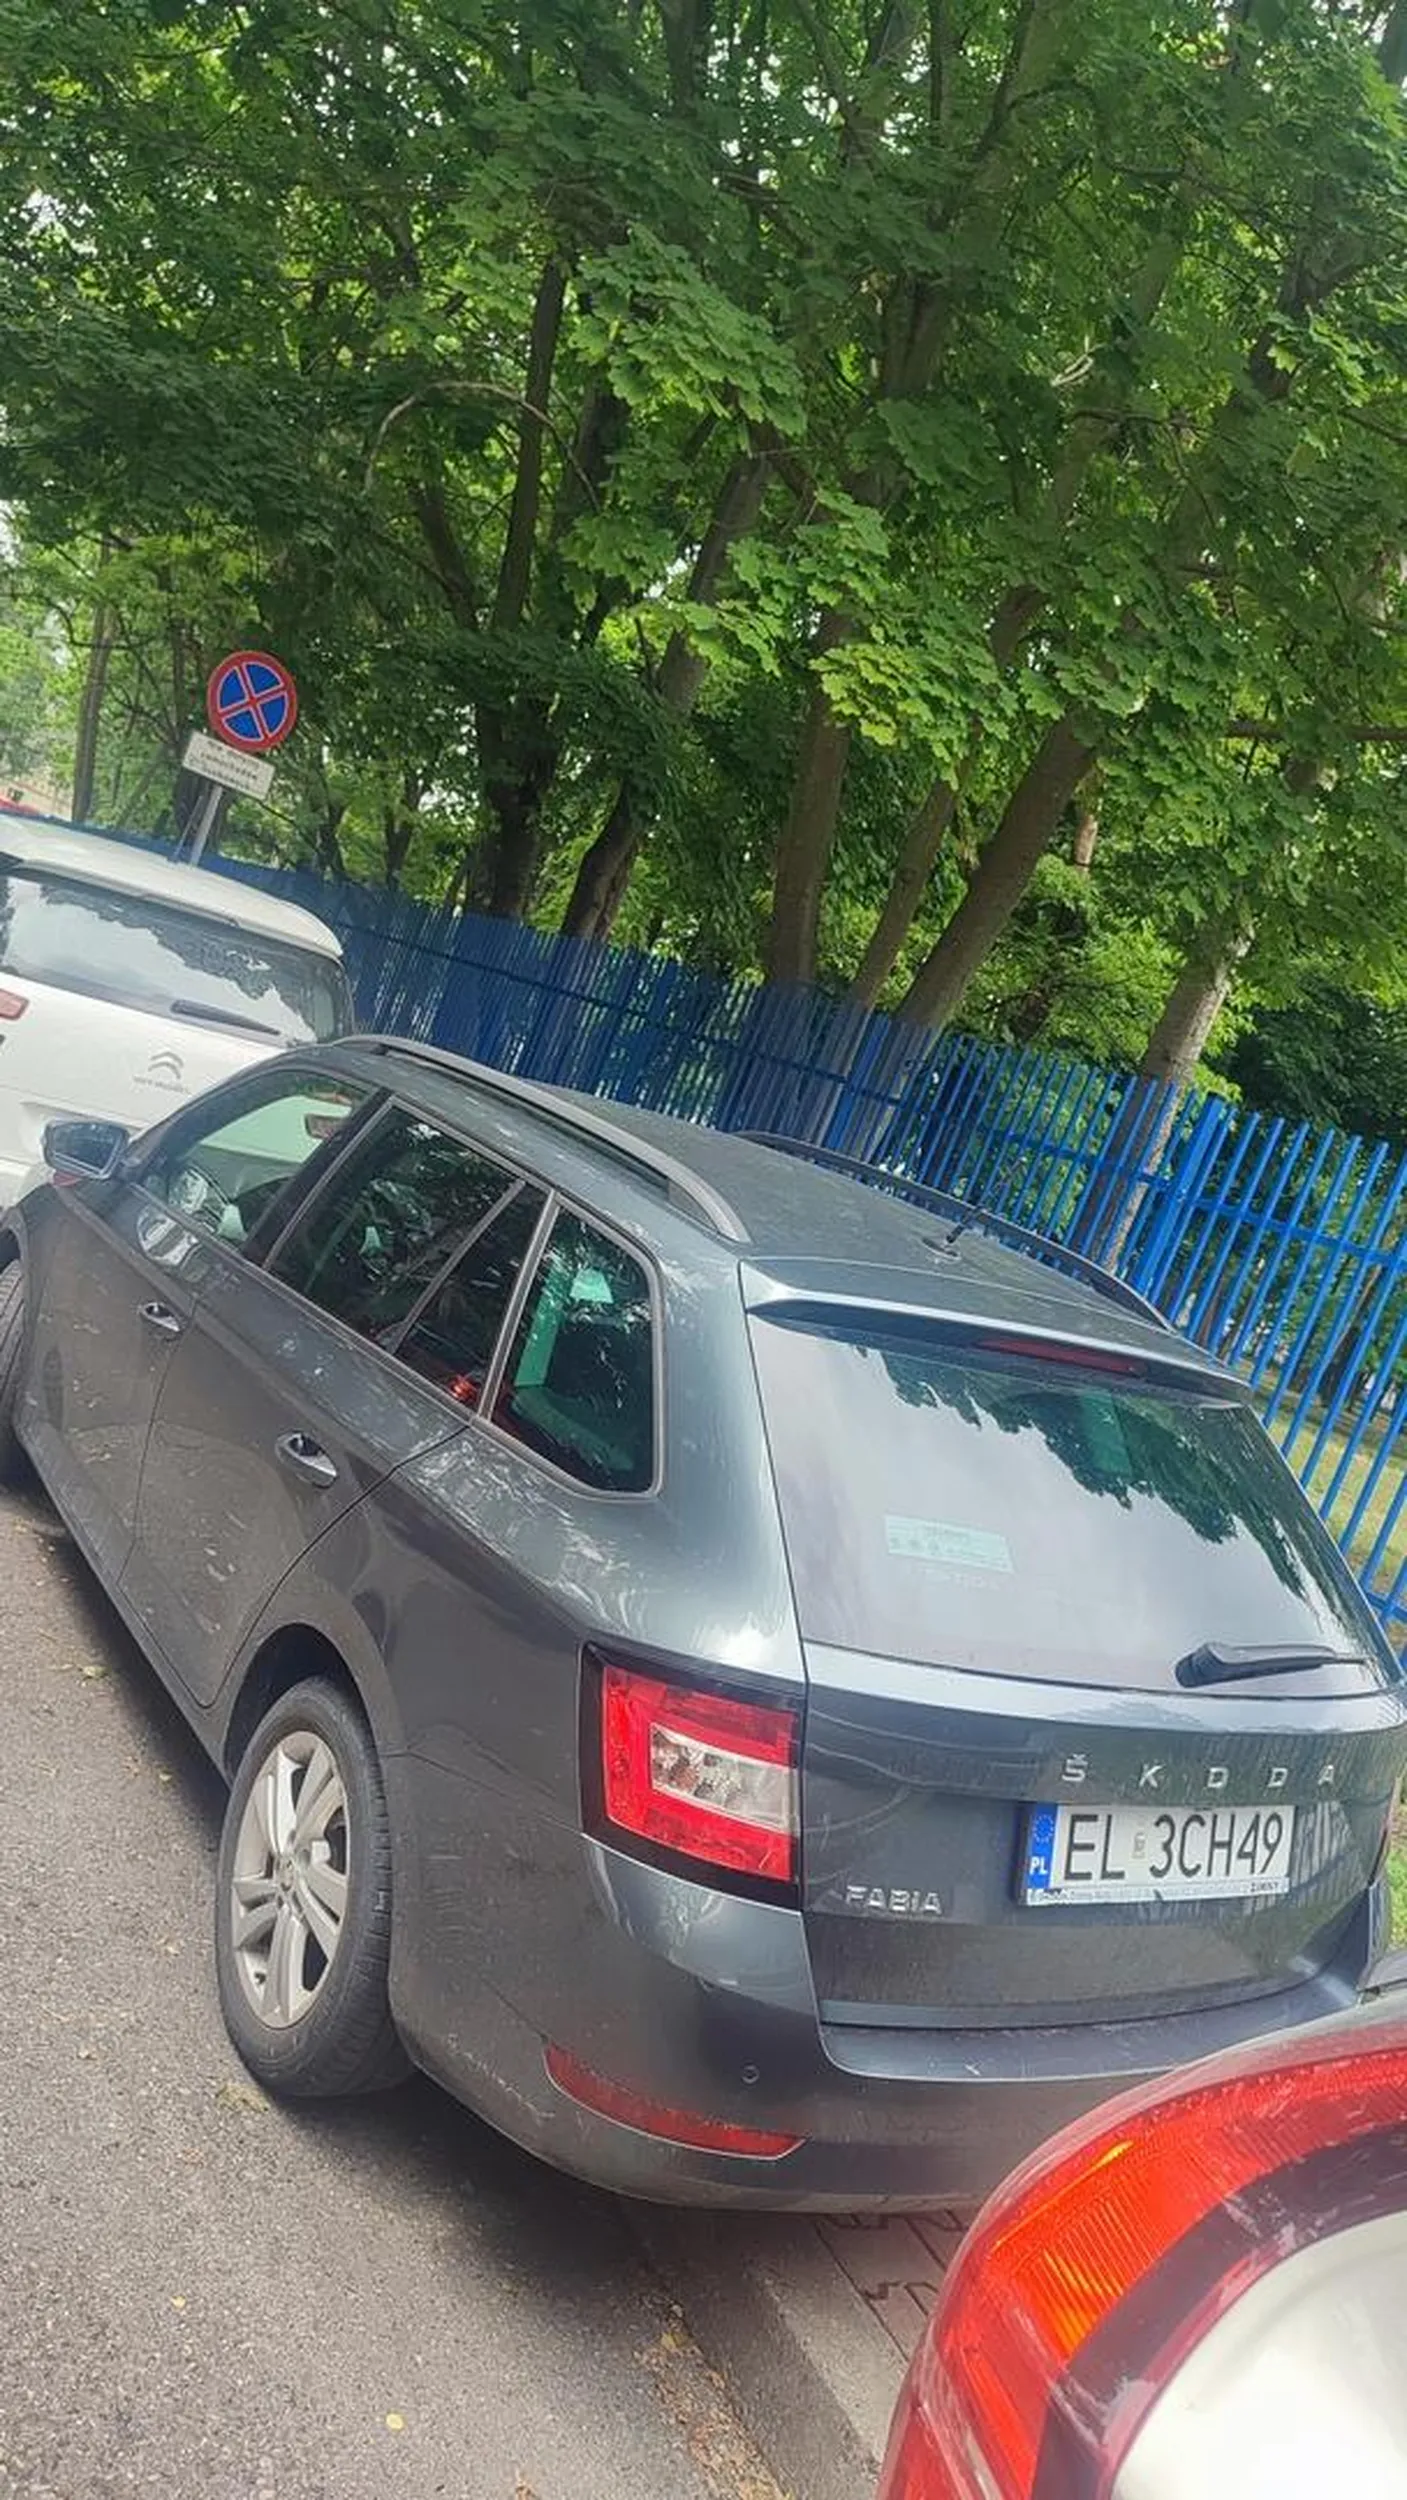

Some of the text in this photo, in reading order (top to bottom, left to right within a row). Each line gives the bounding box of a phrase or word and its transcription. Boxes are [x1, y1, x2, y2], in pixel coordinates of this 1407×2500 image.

[1063, 1813, 1125, 1881] EL
[1150, 1812, 1284, 1879] 3CH49
[1029, 1856, 1048, 1876] PL
[846, 1885, 941, 1914] FABIA
